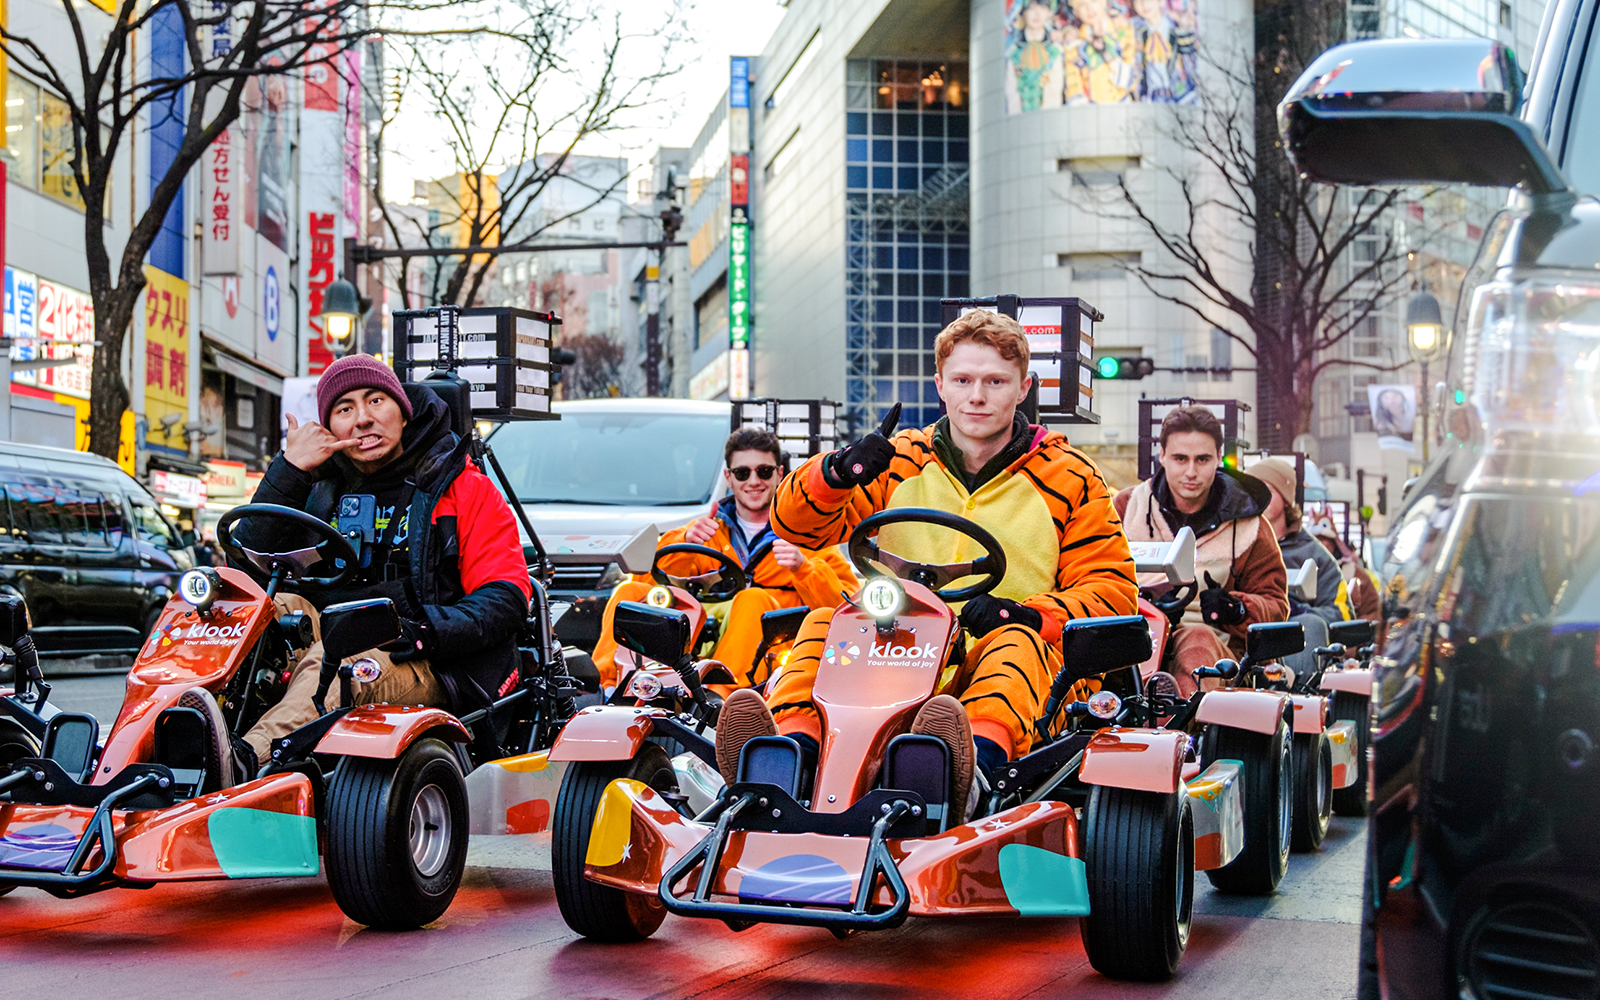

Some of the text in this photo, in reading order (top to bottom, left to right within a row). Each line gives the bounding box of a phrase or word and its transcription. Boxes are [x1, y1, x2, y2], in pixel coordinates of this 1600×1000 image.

[147, 281, 187, 338] クスリ
[186, 622, 247, 638] klook
[868, 641, 939, 659] klook
[921, 660, 934, 668] joy
